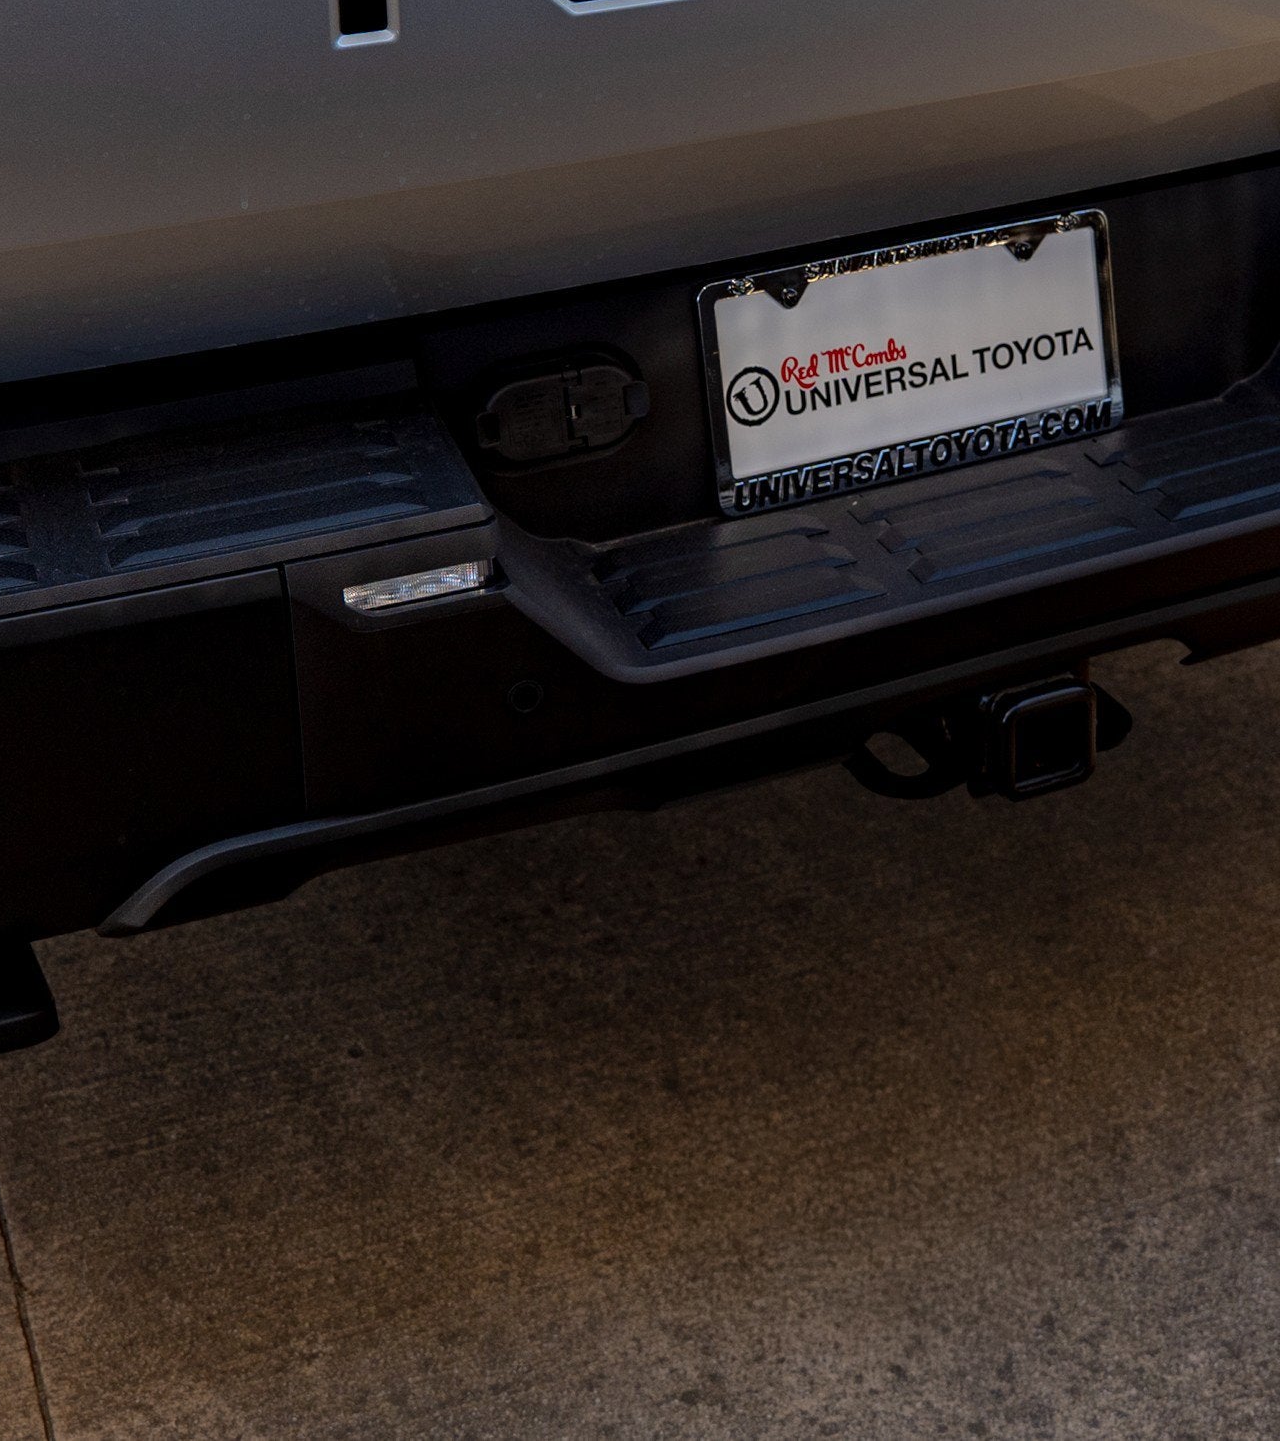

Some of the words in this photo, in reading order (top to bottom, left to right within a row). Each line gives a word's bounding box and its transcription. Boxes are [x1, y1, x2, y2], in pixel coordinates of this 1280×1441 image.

[803, 260, 854, 283] SAN
[781, 355, 821, 389] Red
[821, 338, 908, 374] McCombs
[784, 354, 969, 416] UNIVERSAL
[972, 327, 1095, 375] TOYOTA
[733, 398, 1112, 513] UNIVERSALTOYOTA.COM
